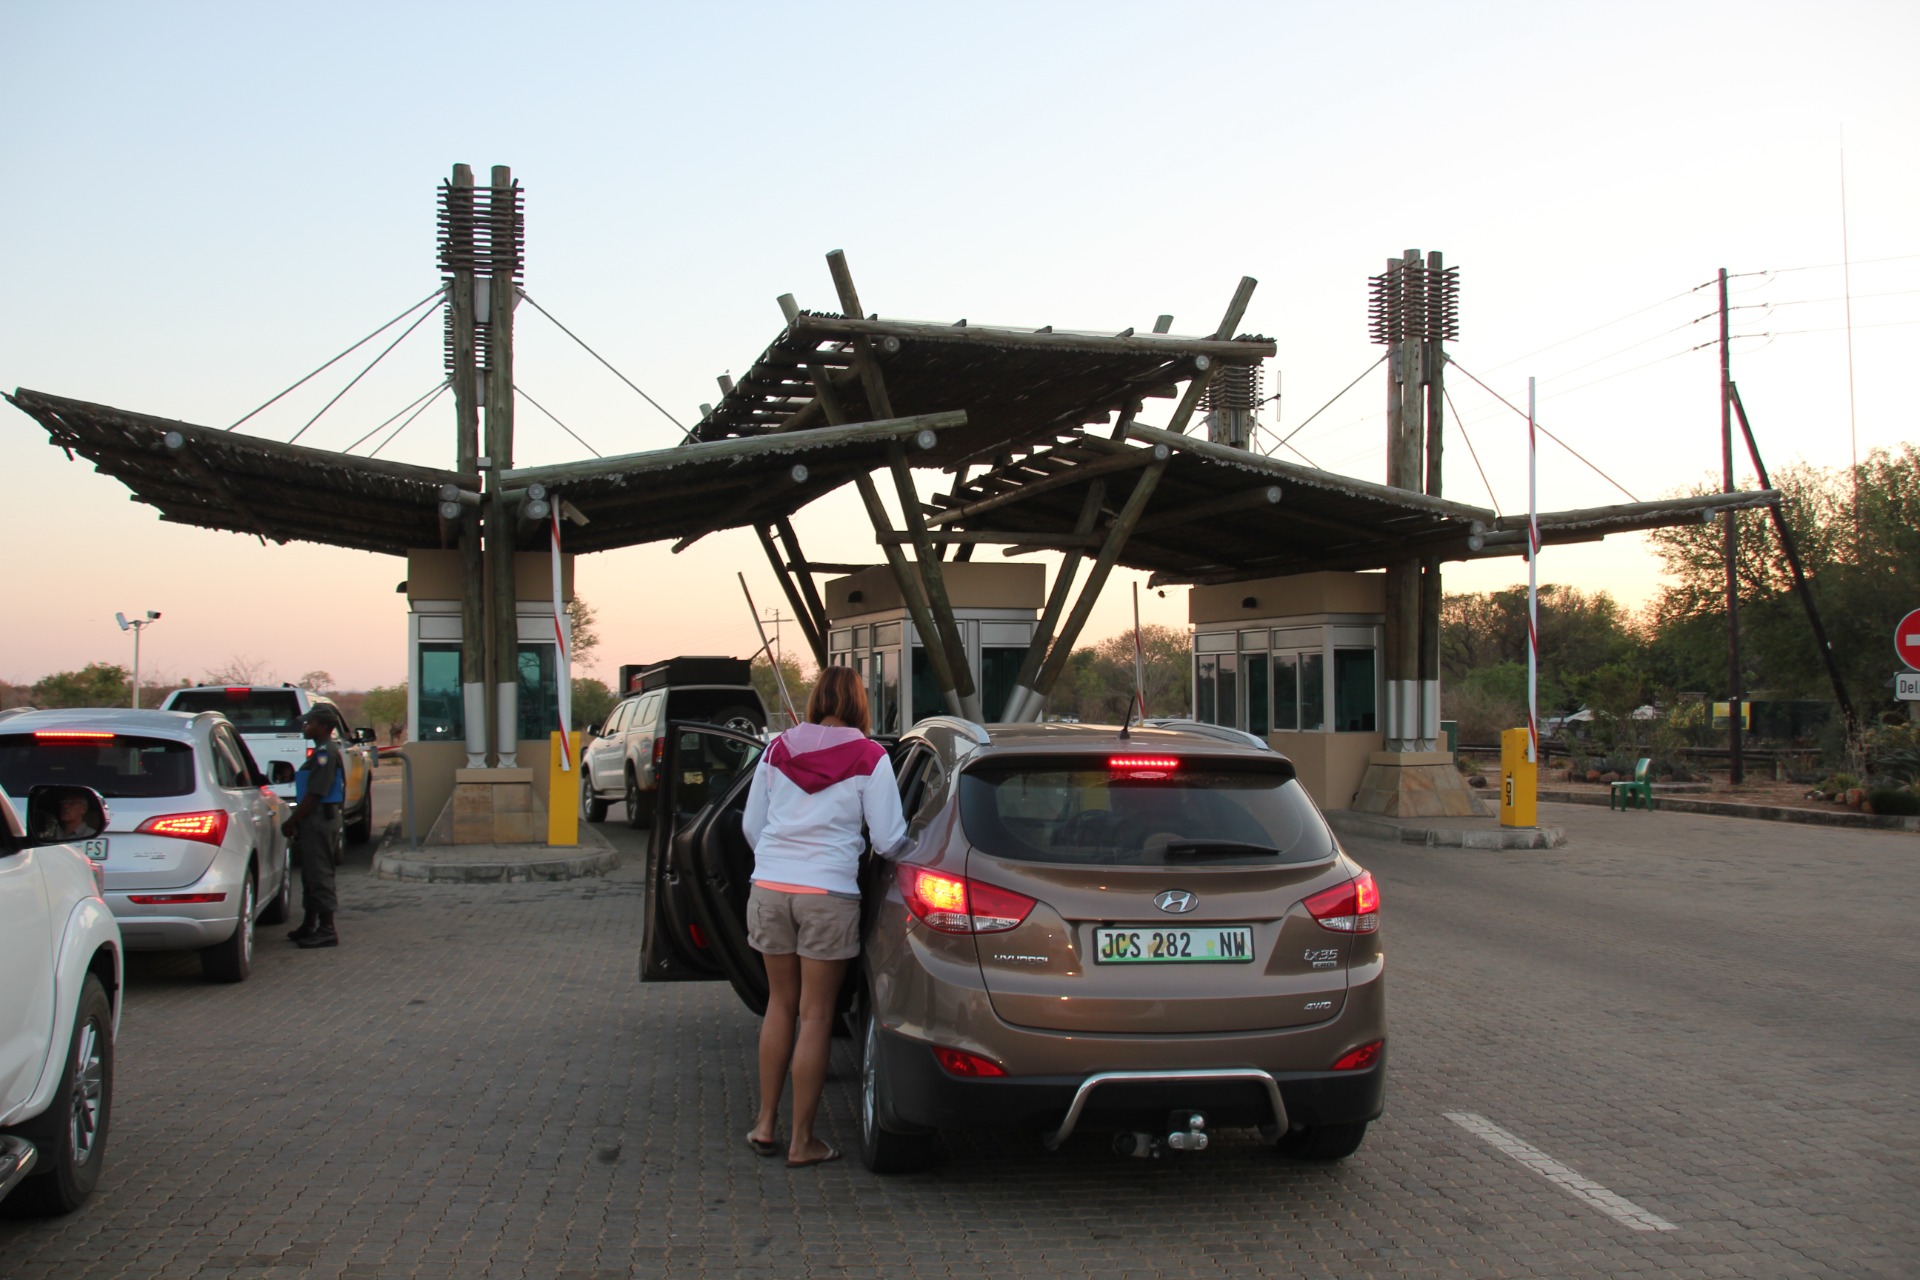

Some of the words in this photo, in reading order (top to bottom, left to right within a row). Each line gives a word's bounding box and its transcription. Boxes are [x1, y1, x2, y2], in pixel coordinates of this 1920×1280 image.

[1900, 680, 1920, 693] Del
[85, 841, 102, 856] FS
[1102, 932, 1142, 958] JCS
[1152, 932, 1192, 958] 282
[1219, 931, 1246, 957] NW
